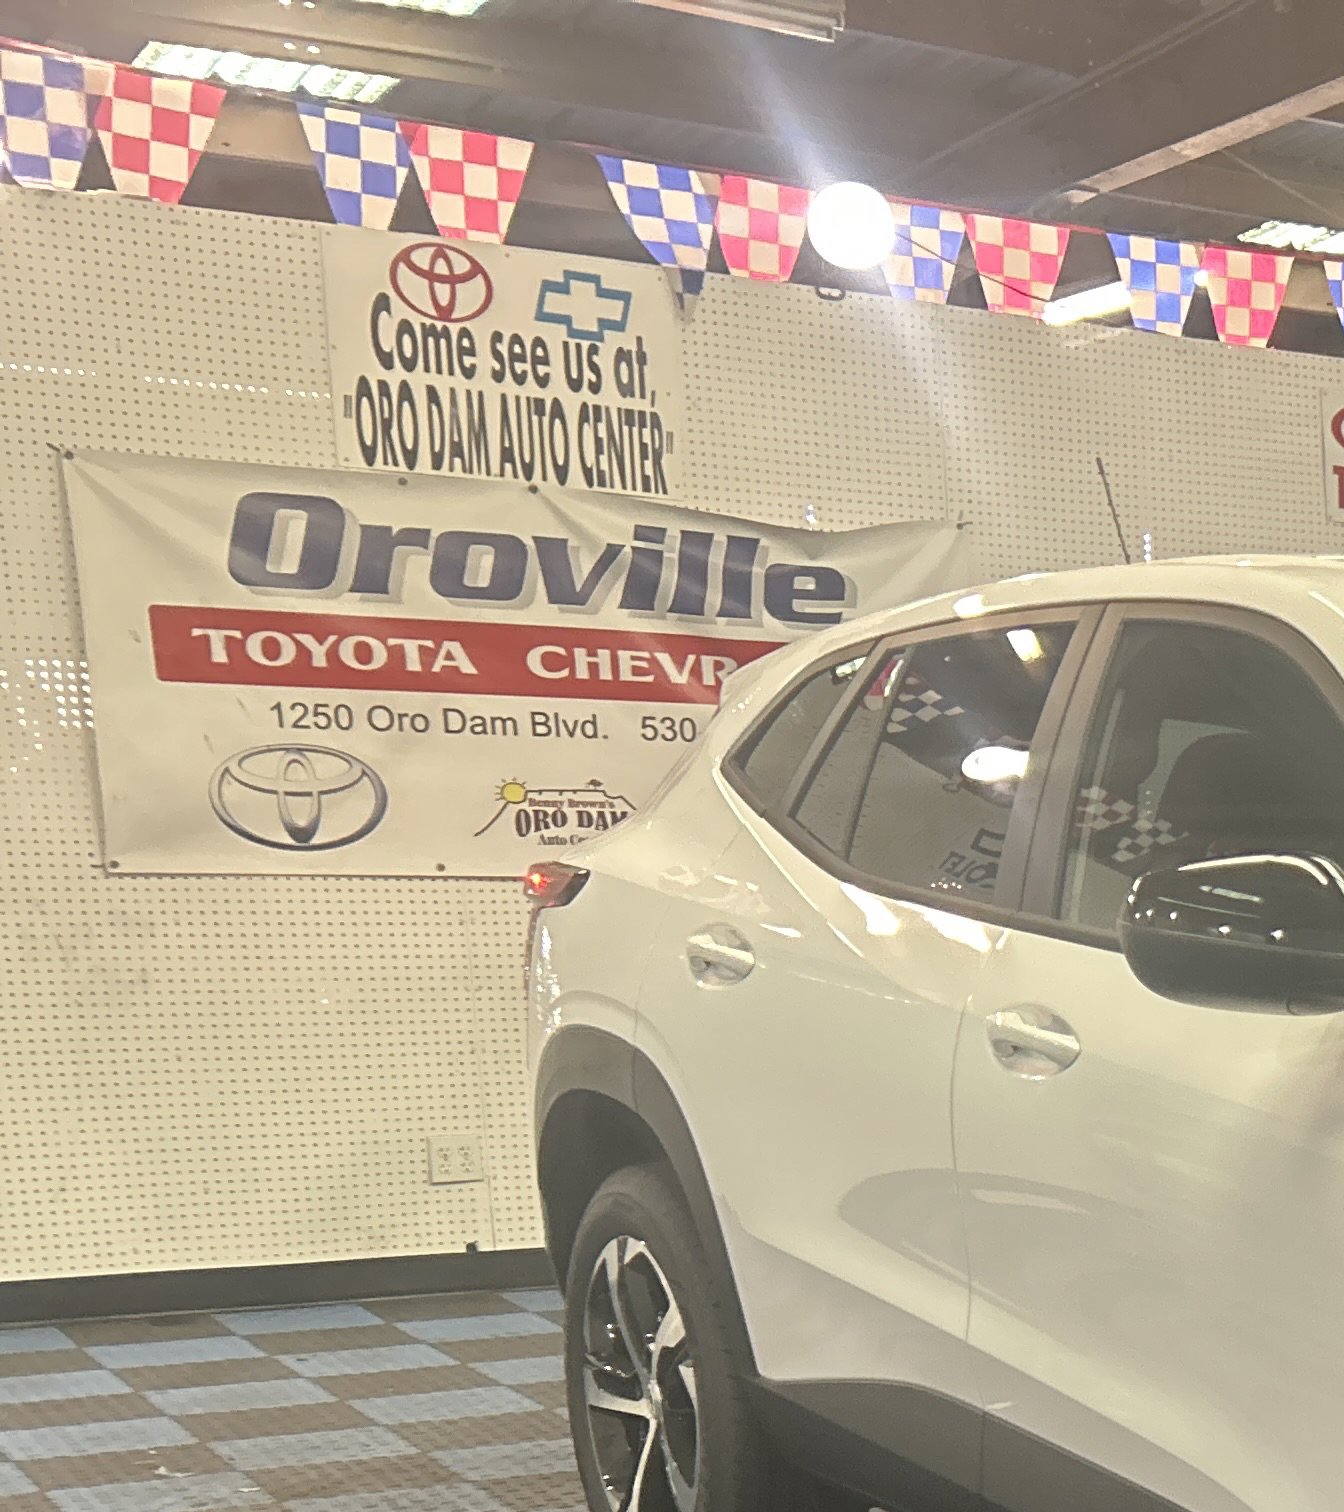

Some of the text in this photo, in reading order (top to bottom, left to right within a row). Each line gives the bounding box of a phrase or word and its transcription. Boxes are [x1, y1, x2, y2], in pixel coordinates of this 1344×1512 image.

[370, 292, 657, 408] Come see us at,
[426, 384, 492, 477] DAM
[499, 392, 569, 487] AUTO
[227, 491, 854, 628] Oroville
[191, 628, 479, 675] TOYOTA
[269, 701, 697, 743] 1250 Oro Dam Blvd. 530
[515, 808, 568, 837] ORO
